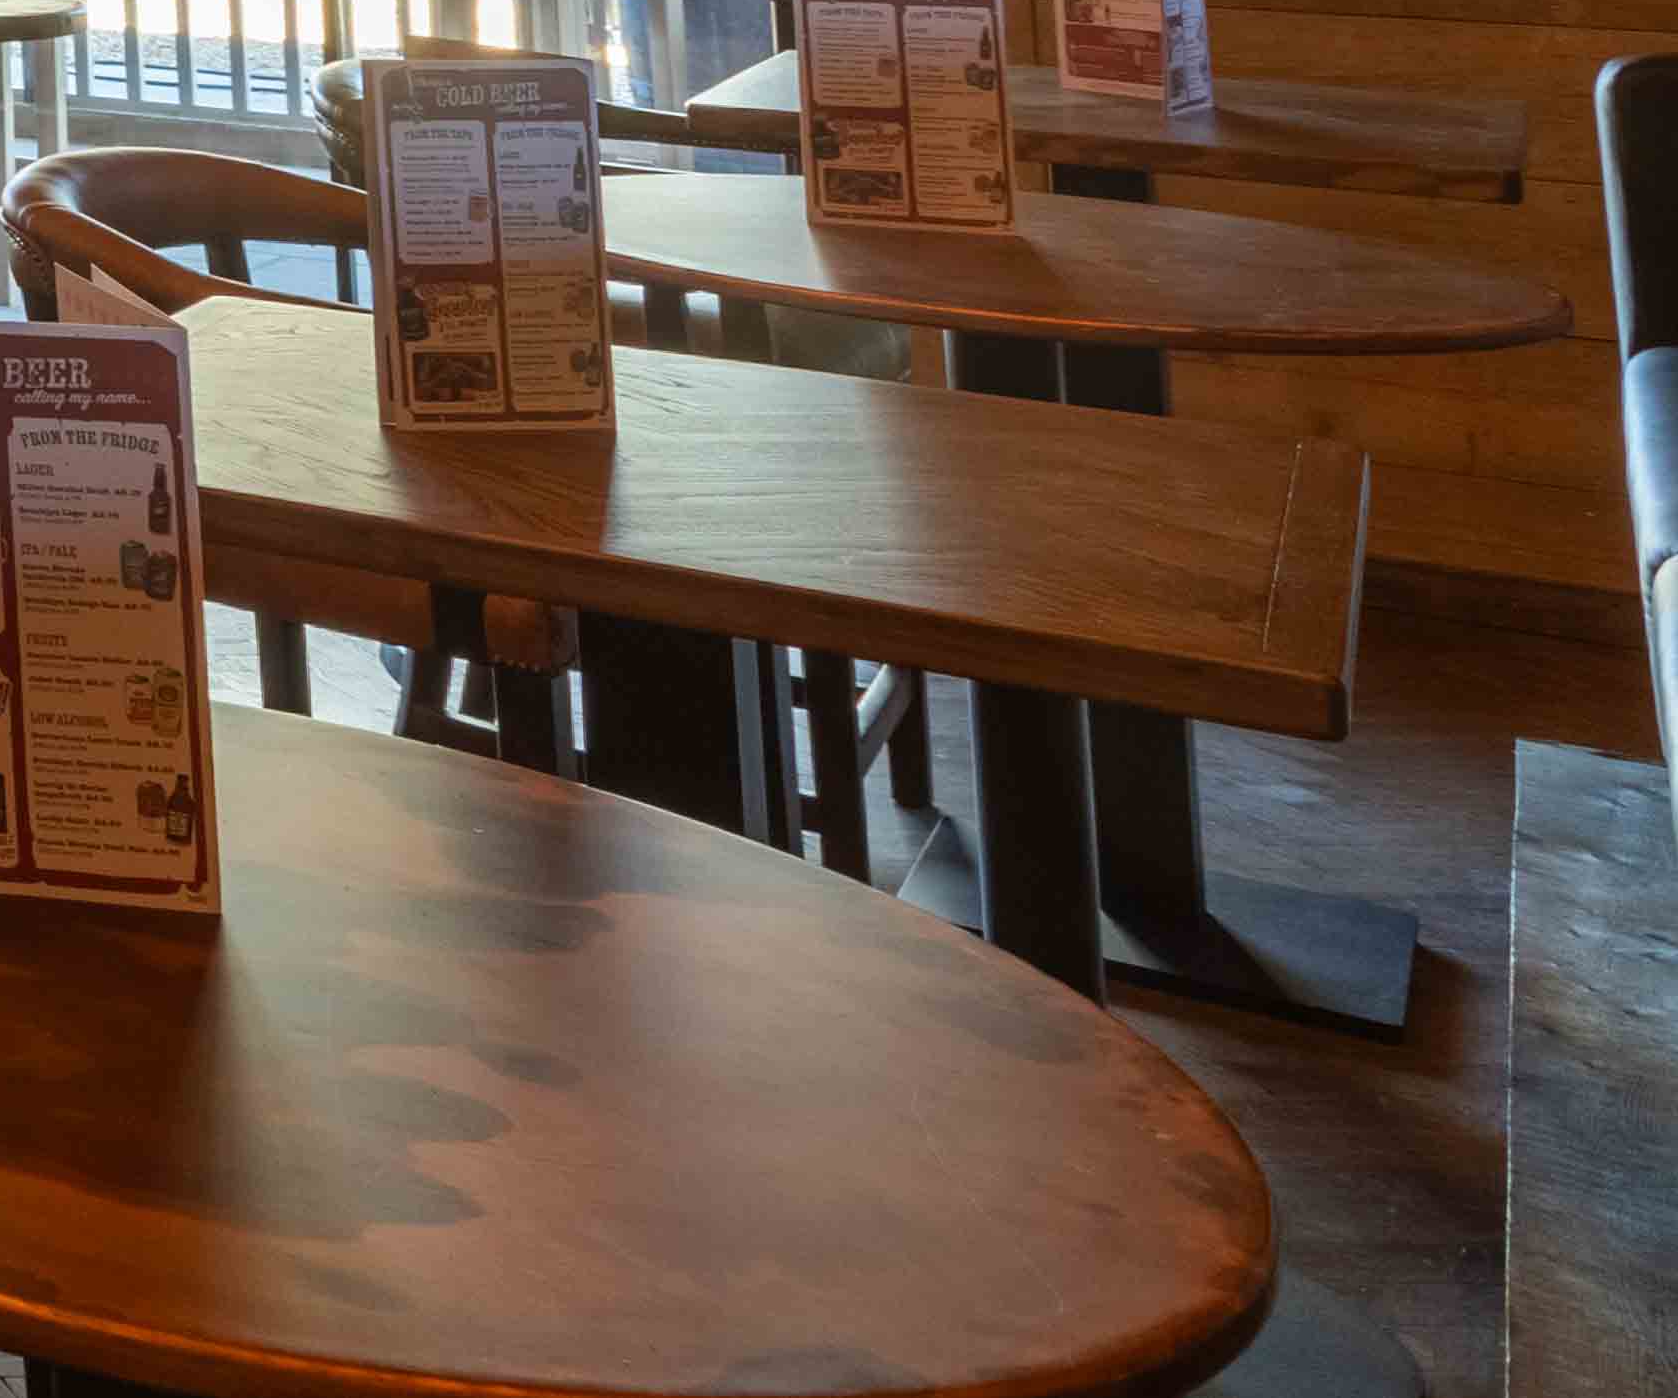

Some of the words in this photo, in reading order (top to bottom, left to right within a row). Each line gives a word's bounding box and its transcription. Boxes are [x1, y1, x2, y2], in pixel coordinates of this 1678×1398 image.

[436, 84, 487, 108] COLD
[3, 358, 92, 389] BEER
[15, 390, 66, 410] calling
[70, 393, 92, 410] my
[20, 430, 62, 449] FROM
[66, 430, 97, 445] THE
[100, 431, 161, 455] FRIDGE
[15, 461, 55, 476] LAGER
